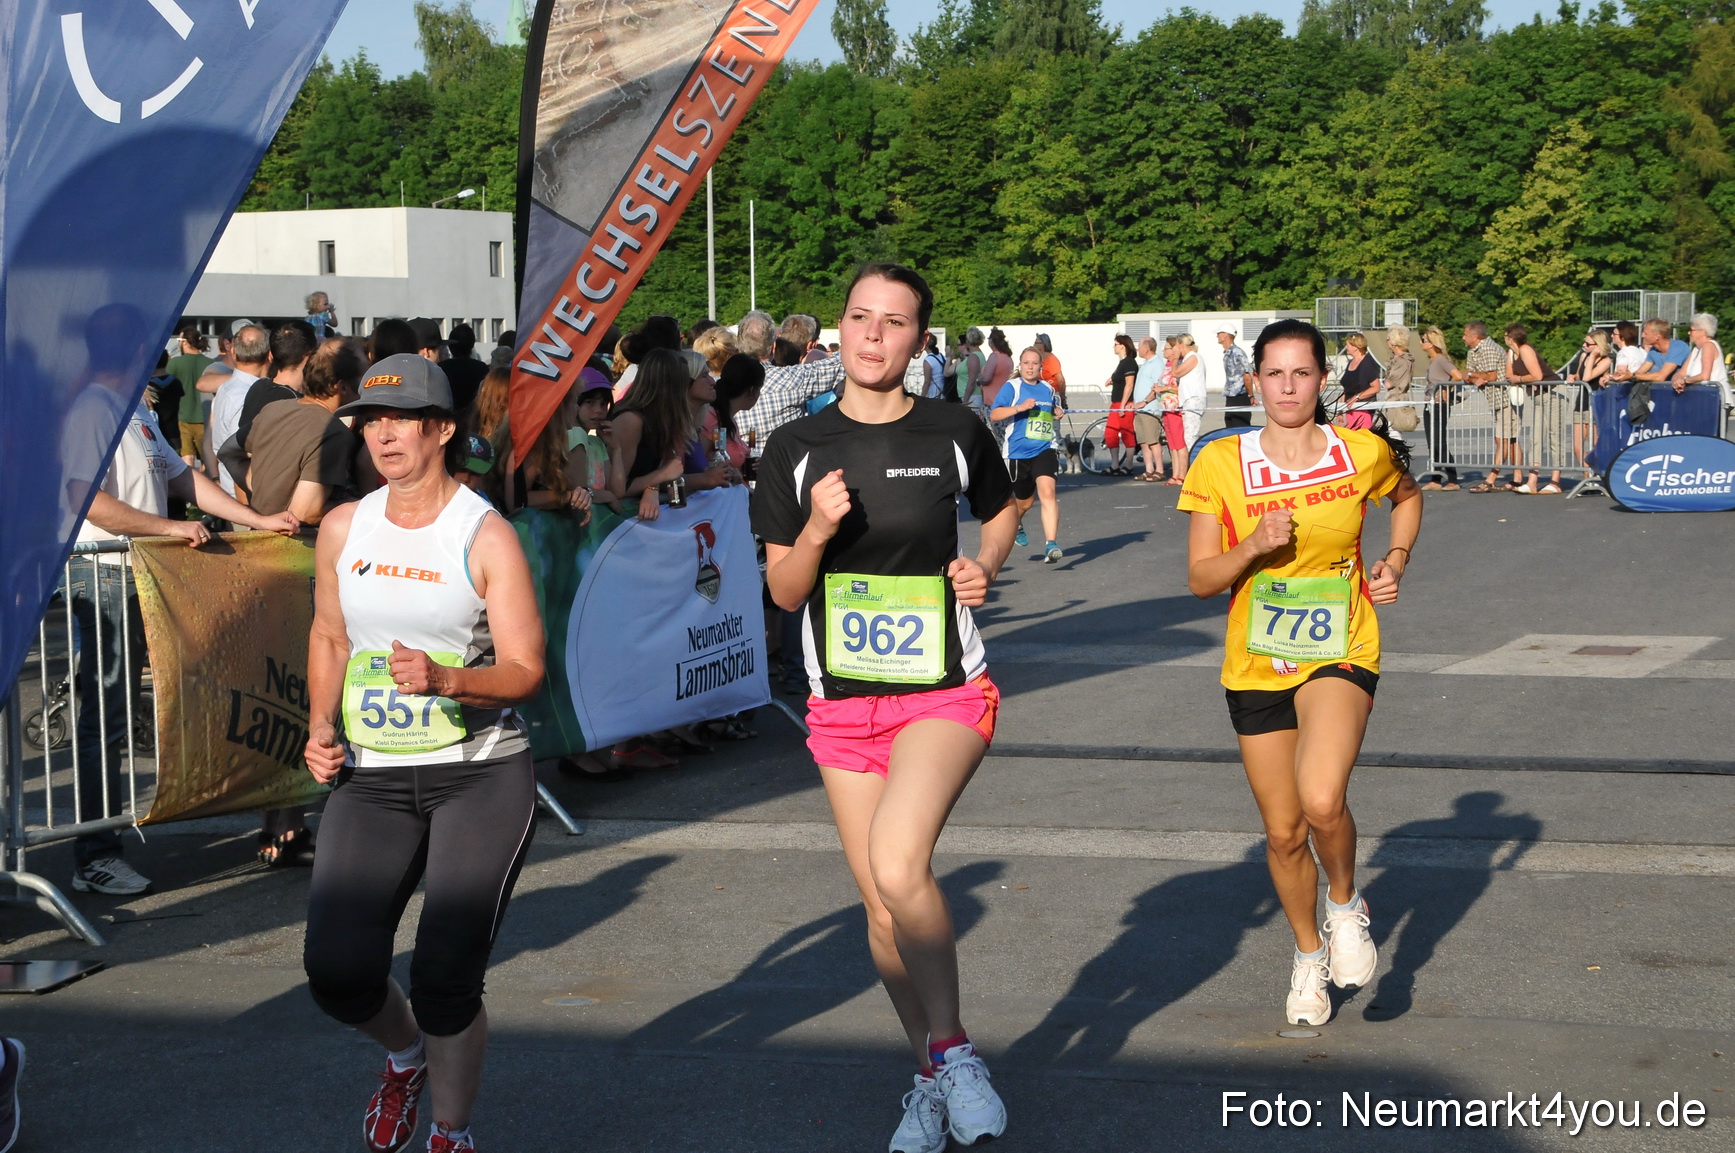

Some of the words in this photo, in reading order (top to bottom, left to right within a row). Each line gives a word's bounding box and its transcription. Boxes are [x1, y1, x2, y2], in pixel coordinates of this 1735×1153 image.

[1028, 420, 1052, 434] 1252
[895, 467, 940, 477] PFLEIDERER
[1645, 468, 1735, 487] Fischer
[1246, 497, 1298, 518] MAX
[1307, 482, 1359, 506] BÖGL
[1654, 485, 1731, 496] AUTOMOBILE
[375, 564, 447, 585] KLEBL
[1263, 604, 1332, 641] 778
[687, 613, 744, 653] Neumarkter
[842, 611, 924, 656] 962
[1273, 639, 1288, 647] Luisa
[840, 663, 866, 671] Pfleiderer
[866, 665, 908, 674] Holzwerkstoffe
[857, 656, 879, 664] Melissa
[880, 658, 911, 666] Eichinger
[675, 642, 755, 701] Lammsbräu
[360, 689, 440, 729] 557
[406, 730, 428, 738] Häring
